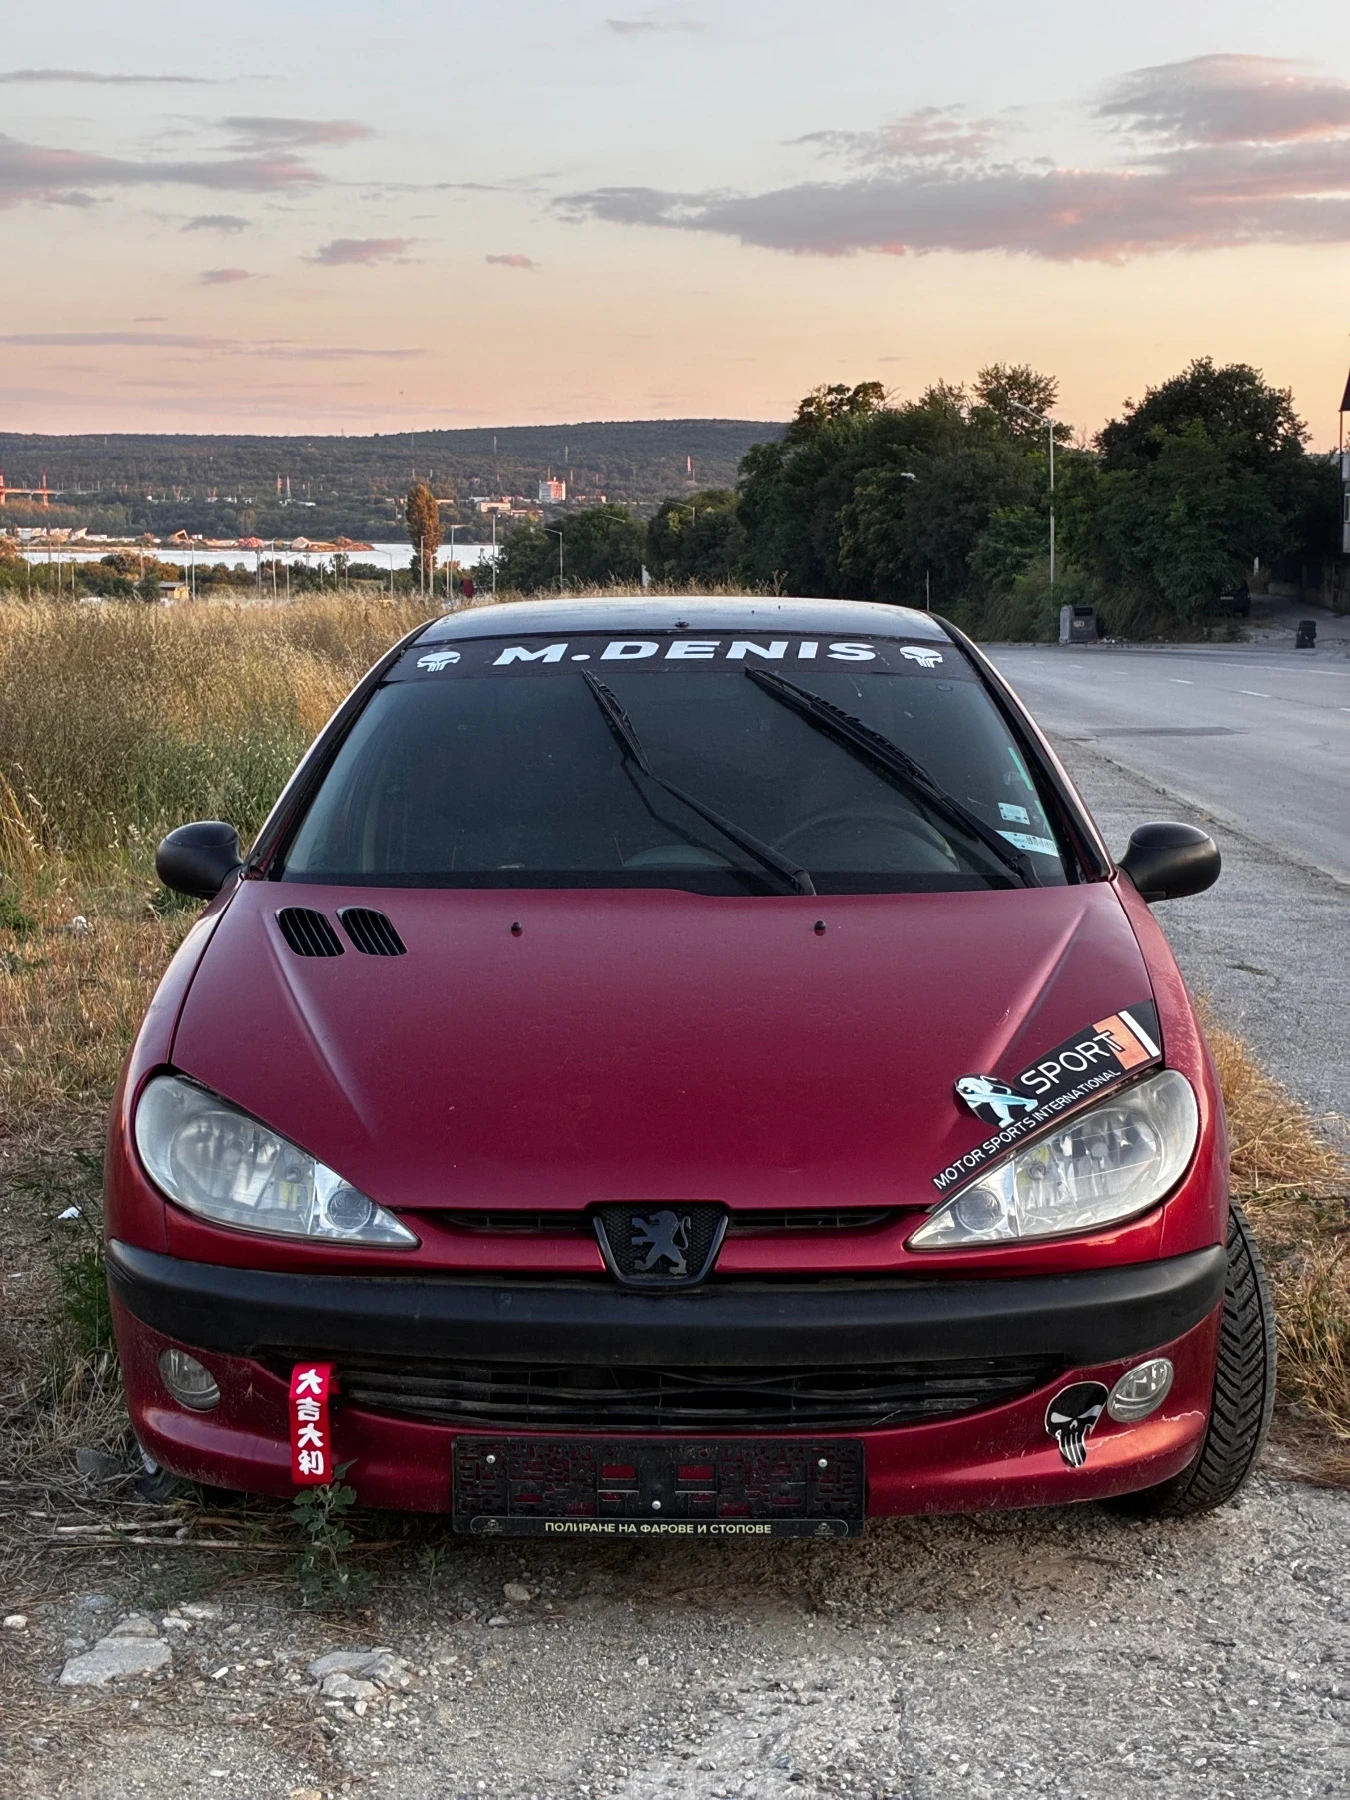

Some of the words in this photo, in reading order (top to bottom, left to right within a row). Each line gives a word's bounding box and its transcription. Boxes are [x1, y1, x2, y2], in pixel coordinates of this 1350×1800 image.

[492, 640, 876, 666] M.DENIS
[1020, 1030, 1125, 1095] SPORT
[932, 1149, 986, 1190] MOTOR
[982, 1116, 1036, 1154] SPORTS
[1031, 1069, 1122, 1122] INTERNATIONAL
[295, 1368, 325, 1476] 大吉大利
[544, 1522, 616, 1533] ПОЛИРАНЕ
[618, 1523, 638, 1533] НА
[640, 1523, 694, 1534] ФАРОВЕ
[697, 1524, 707, 1534] И
[709, 1524, 772, 1534] СТОПОВЕ
